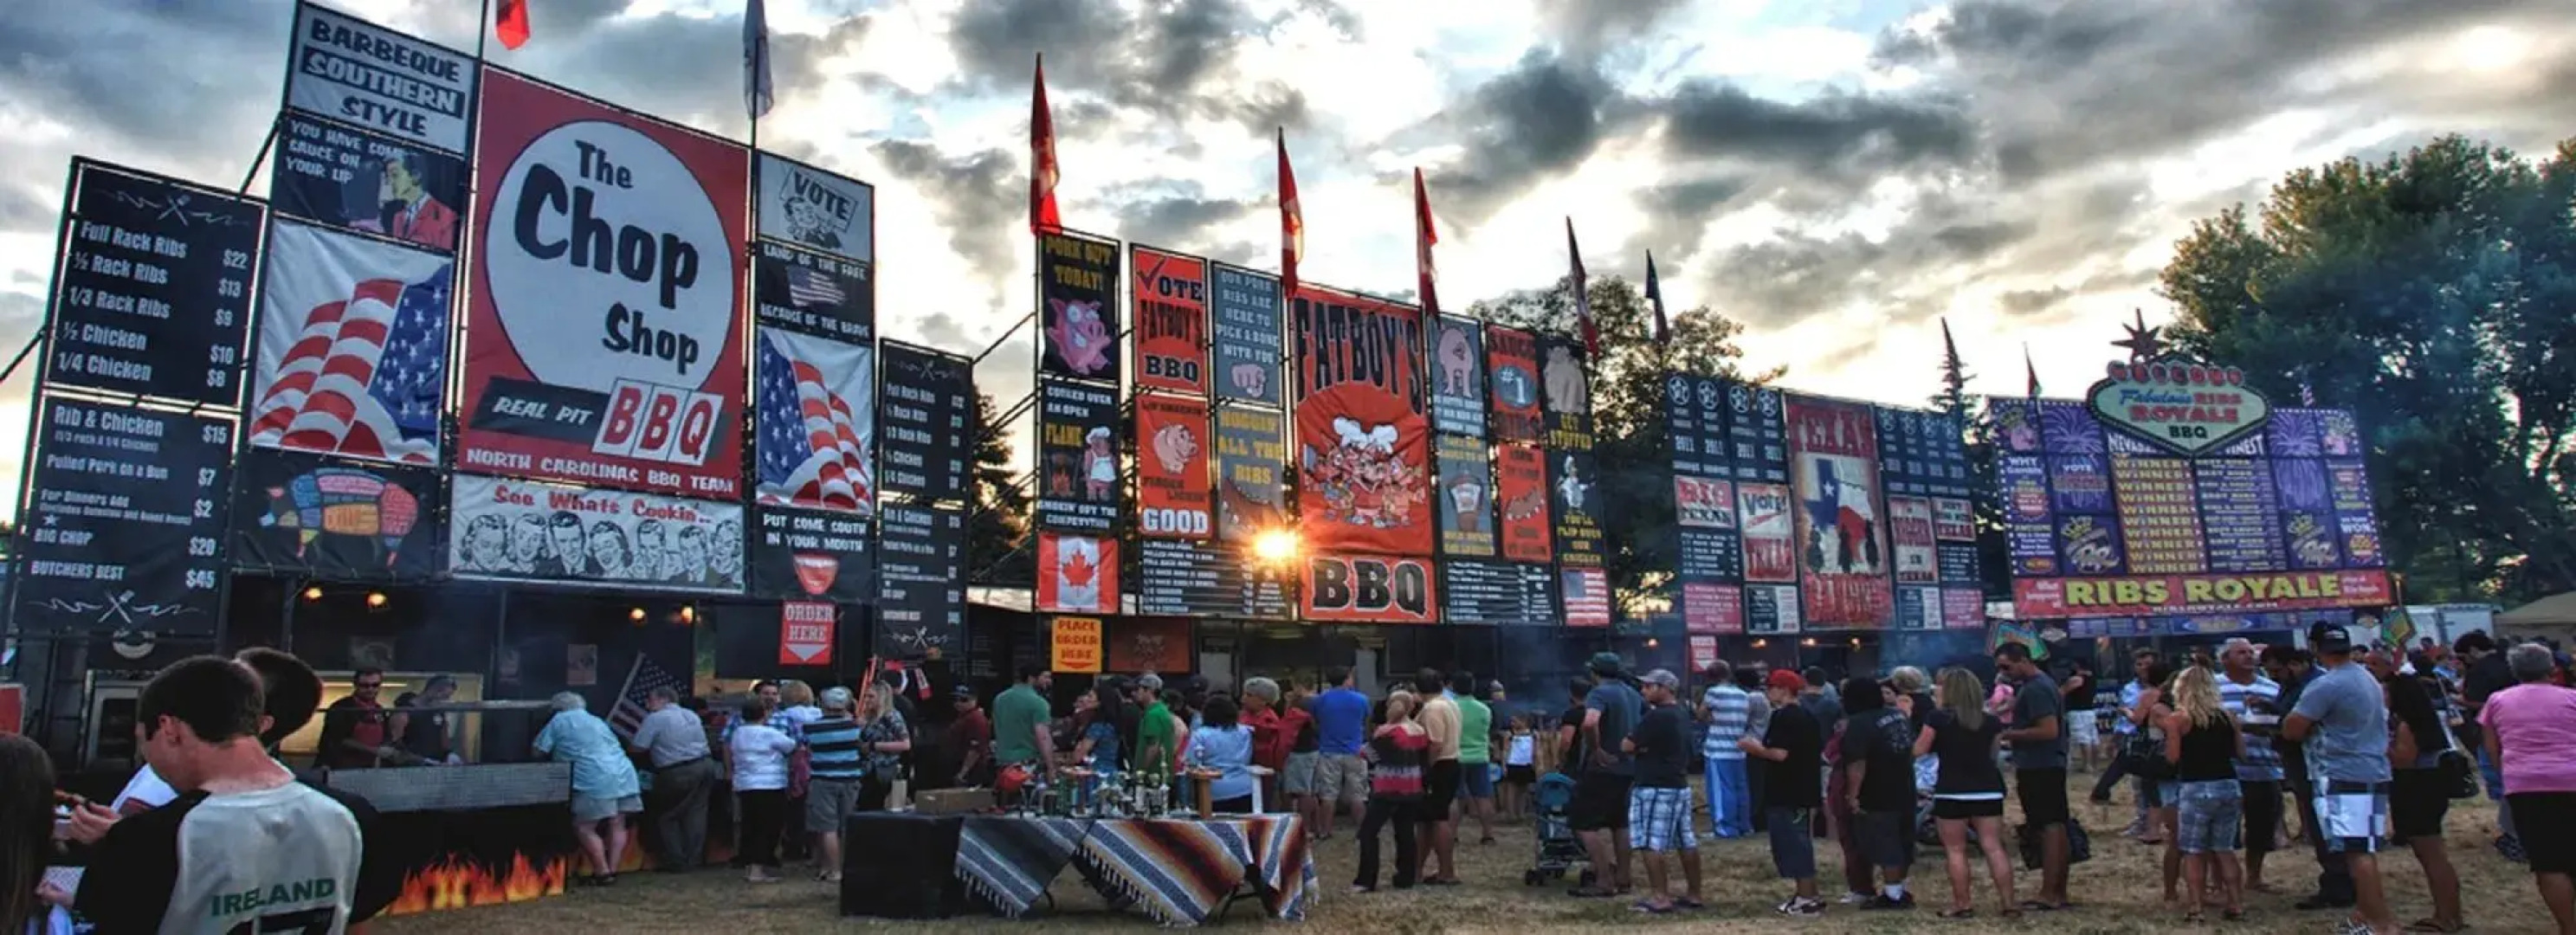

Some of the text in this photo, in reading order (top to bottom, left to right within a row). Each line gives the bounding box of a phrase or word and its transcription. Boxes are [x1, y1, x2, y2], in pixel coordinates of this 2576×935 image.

[311, 17, 461, 82] BARBEQUE
[307, 52, 459, 114] SOUTHERN
[340, 96, 427, 136] STYLE
[290, 119, 320, 139] YOU
[326, 131, 361, 150] HAVE
[286, 155, 353, 184] YOUR LIP
[340, 152, 360, 170] ON
[575, 140, 633, 190] The
[794, 171, 850, 220] VOTE
[81, 221, 249, 269] Full Rack Ribs $22
[513, 162, 700, 309] Chop
[1046, 235, 1113, 265] PORK OUT
[763, 242, 794, 262] LAND
[797, 252, 811, 266] OF
[818, 259, 836, 273] THE
[92, 255, 131, 277] Rack
[133, 261, 168, 285] Ribs
[218, 279, 241, 298] $13
[1054, 264, 1103, 291] TODAY!
[1220, 270, 1242, 286] OUR
[69, 286, 233, 327] 1/3 Rack Ribs $9
[1223, 288, 1272, 309] RIBS ARE
[1225, 306, 1271, 327] HERE TO
[81, 323, 147, 351] Chicken
[210, 345, 234, 364] $10
[602, 302, 699, 375] Shop
[1216, 323, 1242, 340] PICK
[1252, 330, 1278, 346] BONE
[1223, 343, 1273, 364] WITH YOU
[1294, 297, 1424, 417] FATBOY'S
[57, 351, 226, 387] 1/4 Chicken $8
[1144, 354, 1200, 384] BBQ
[1046, 386, 1113, 406] COOKED OVER
[1499, 364, 1526, 404] #1
[55, 406, 227, 443] Rib & Chicken $15
[1046, 403, 1089, 418] AN OPEN
[2128, 404, 2239, 423] ROYALE
[493, 385, 713, 466] REAL PIT BBQ
[2168, 425, 2208, 439] BBQ
[1218, 435, 1283, 458] ALL THE
[47, 454, 86, 470] Pulled
[88, 458, 117, 474] Pork
[197, 468, 216, 487] $7
[466, 448, 735, 493] NORTH CAROLINAS BBQ TEAM
[1235, 465, 1273, 485] RIBS
[194, 500, 213, 518] $2
[494, 484, 535, 506] See
[548, 490, 620, 514] Whats
[1077, 503, 1097, 515] OUT
[763, 513, 786, 528] PUT
[1142, 508, 1209, 534] GOOD
[34, 528, 216, 556] BIG CHOP $20
[766, 532, 863, 552] IN YOUR MOUTH
[30, 561, 216, 589] BUTCHERS BEST $45
[1310, 557, 1428, 619] BBQ
[2065, 579, 2170, 605] RIBS
[2183, 574, 2341, 603] ROYALE
[784, 603, 836, 622] ORDER
[1058, 620, 1094, 631] PLACE
[788, 625, 827, 642] HERE
[1056, 635, 1097, 645] ORDER
[1061, 649, 1094, 660] HERE
[211, 877, 337, 917] IRELAND
